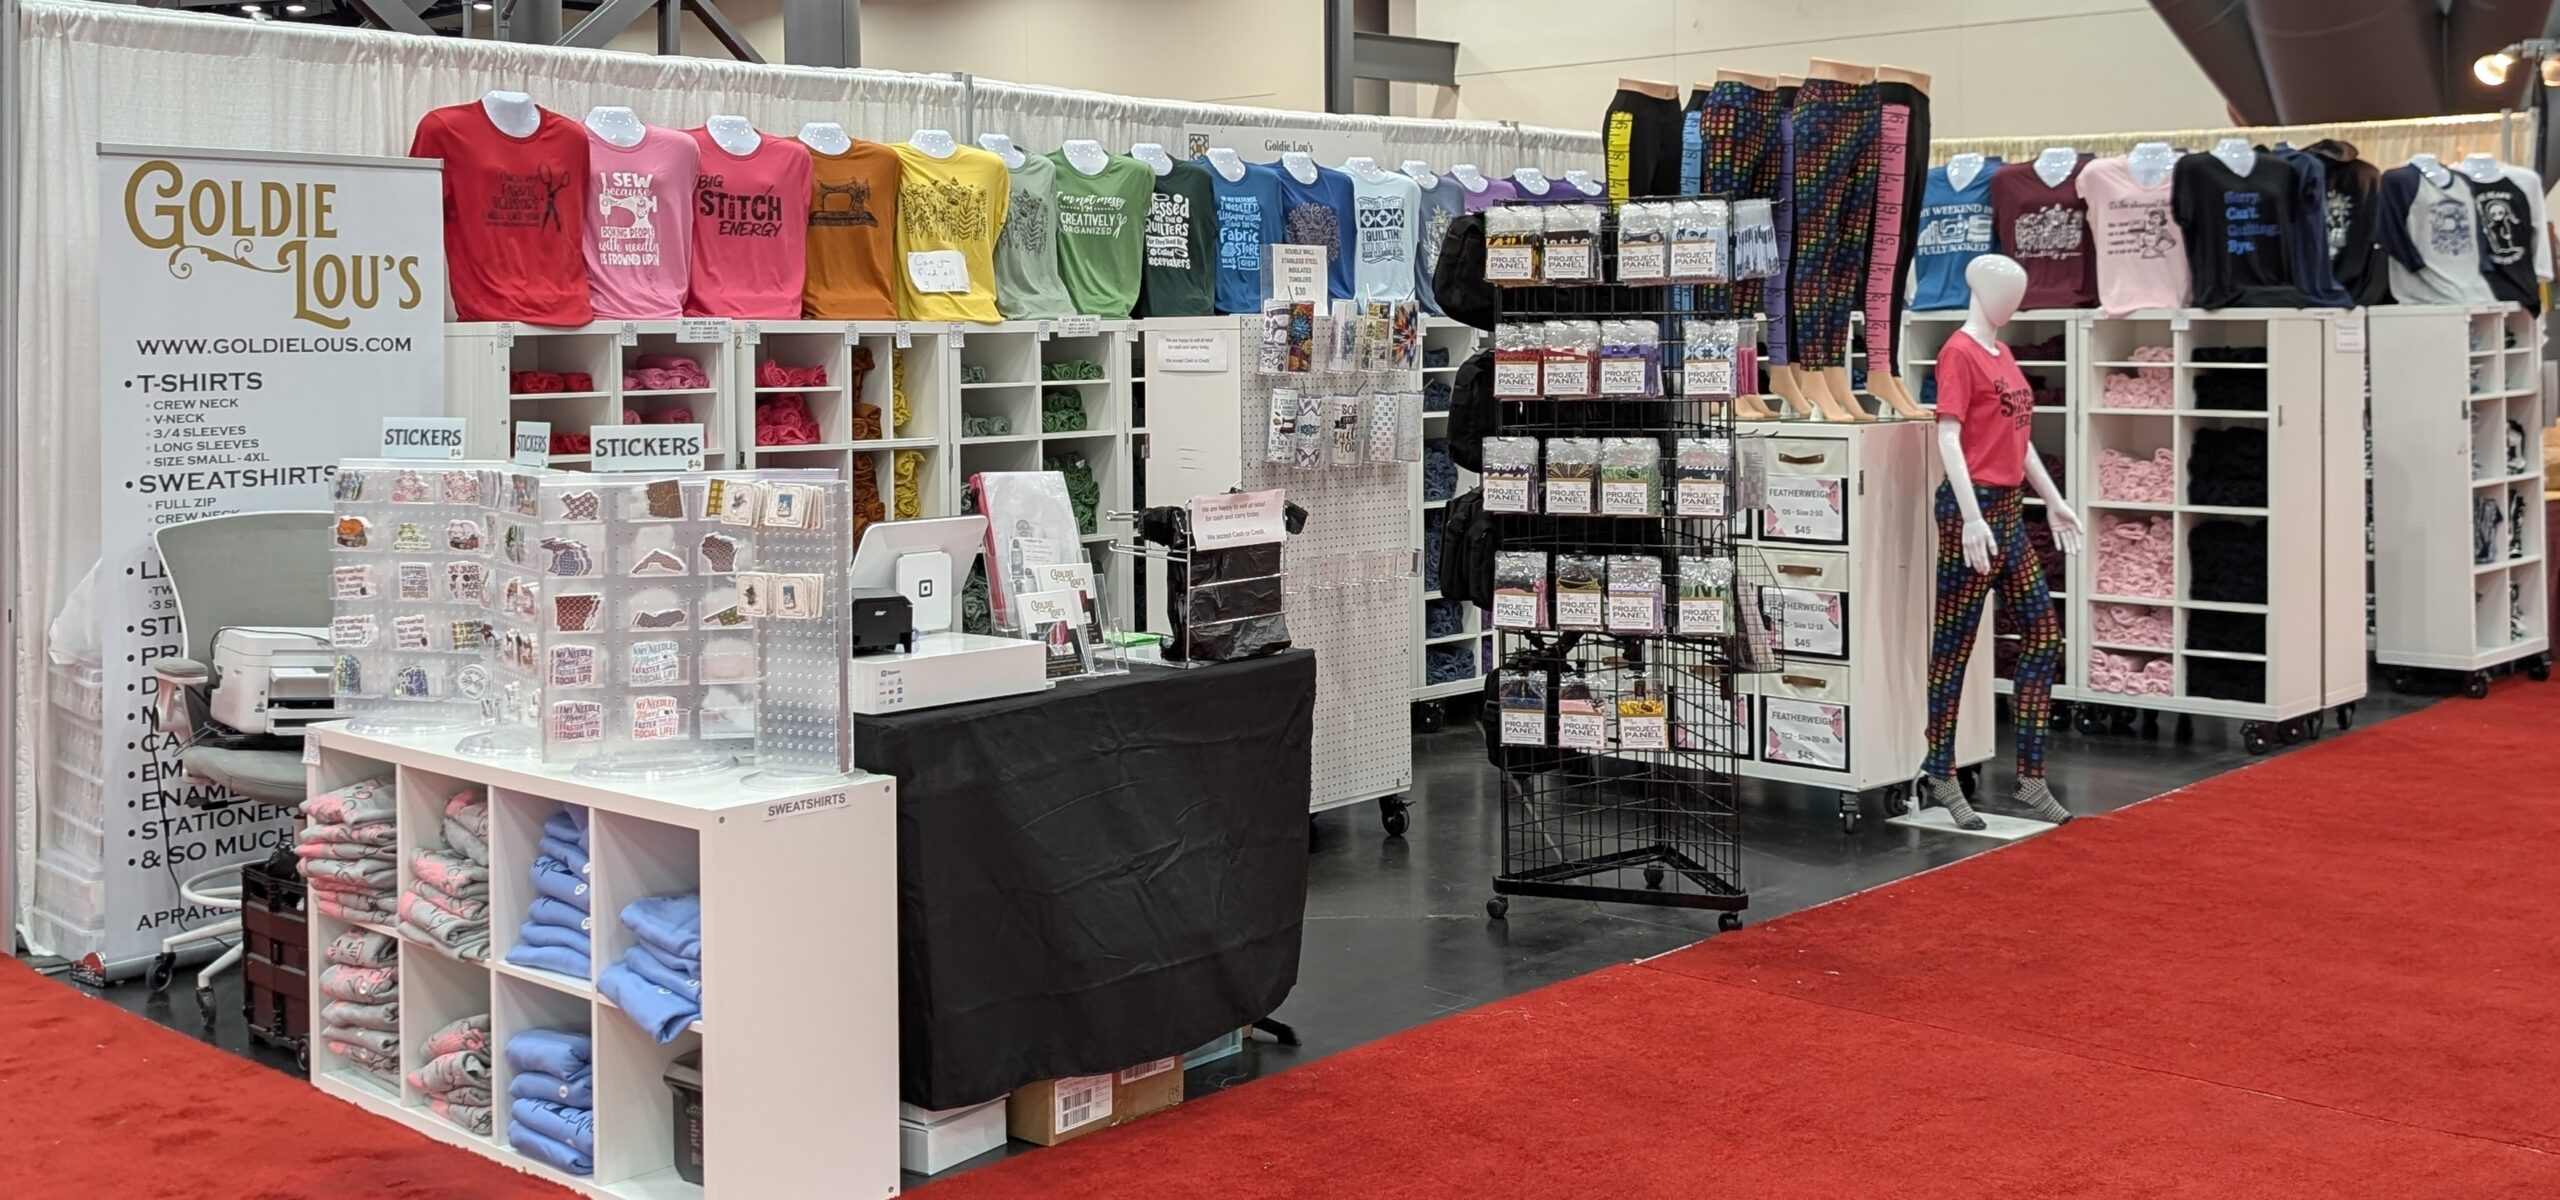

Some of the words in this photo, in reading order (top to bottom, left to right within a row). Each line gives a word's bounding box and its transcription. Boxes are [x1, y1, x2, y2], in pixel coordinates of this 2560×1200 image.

[1265, 139, 1291, 151] Goldie
[601, 172, 607, 186] I
[612, 172, 653, 188] SEW
[697, 174, 724, 189] BIG
[602, 186, 652, 198] because
[124, 160, 337, 249] GOLDIE
[1933, 205, 1982, 216] WEEKEND
[1060, 212, 1115, 226] CREATIVELY
[719, 221, 783, 237] ENERGY
[1063, 225, 1112, 235] ORGANIZED
[1220, 227, 1259, 244] Fabric
[1674, 251, 1713, 259] PROJECT
[1919, 245, 1950, 256] FULLY
[1548, 255, 1586, 263] PROJECT
[1622, 254, 1660, 262] PROJECT
[277, 240, 421, 329] LOU'S
[1295, 286, 1307, 296] $30
[137, 337, 411, 355] WWW.GOLDIELOUS.COM
[735, 336, 742, 349] 2
[1498, 372, 1535, 380] PROJECT
[1547, 371, 1584, 379] PROJECT
[137, 372, 263, 393] T-SHIRTS
[153, 399, 196, 410] CREW
[200, 398, 239, 409] NECK
[154, 413, 205, 424] V-NECK
[153, 427, 180, 438] 3/4
[183, 425, 246, 437] SLEEVES
[384, 428, 462, 447] STICKERS
[154, 441, 192, 453] LONG
[196, 439, 259, 450] SLEEVES
[517, 434, 546, 453] STICKERS
[596, 436, 700, 459] STICKERS
[451, 448, 461, 457] $4
[154, 455, 184, 467] SIZE
[688, 460, 701, 468] $4
[139, 465, 338, 493] SWEATSHIRTS
[1487, 488, 1525, 496] PROJECT
[1769, 488, 1837, 499] FEATHERWEIGHT
[156, 500, 191, 510] FULL
[194, 498, 216, 508] ZIP
[1219, 504, 1233, 512] happy
[155, 512, 198, 524] CREW
[1232, 530, 1245, 538] Cash
[1794, 524, 1811, 535] $45
[461, 565, 479, 573] JUST
[1050, 569, 1074, 580] GOLDIE
[1069, 577, 1086, 588] LOU'S
[1031, 600, 1055, 612] GOLDIE
[1497, 603, 1534, 611] PROJECT
[1560, 601, 1598, 609] PROJECT
[1768, 600, 1836, 613] FEATHERWEIGHT
[1048, 608, 1065, 619] LOU'S
[1497, 609, 1533, 617] PANEL
[1560, 607, 1598, 615] PANEL
[1612, 611, 1650, 619] PANEL
[1794, 637, 1811, 648] $45
[556, 649, 566, 658] MY
[579, 674, 592, 682] LIFE
[563, 706, 573, 714] MY
[1772, 711, 1840, 726] FEATHERWEIGHT
[1505, 727, 1542, 735] PANEL
[1563, 723, 1601, 731] PROJECT
[587, 729, 600, 738] LIFE
[1564, 729, 1600, 737] PANEL
[1781, 732, 1792, 740] TC2
[1797, 749, 1815, 760] $45
[767, 792, 846, 817] SWEATSHIRTS
[142, 806, 292, 840] STATIONER
[141, 850, 161, 869] &
[169, 842, 206, 865] SO
